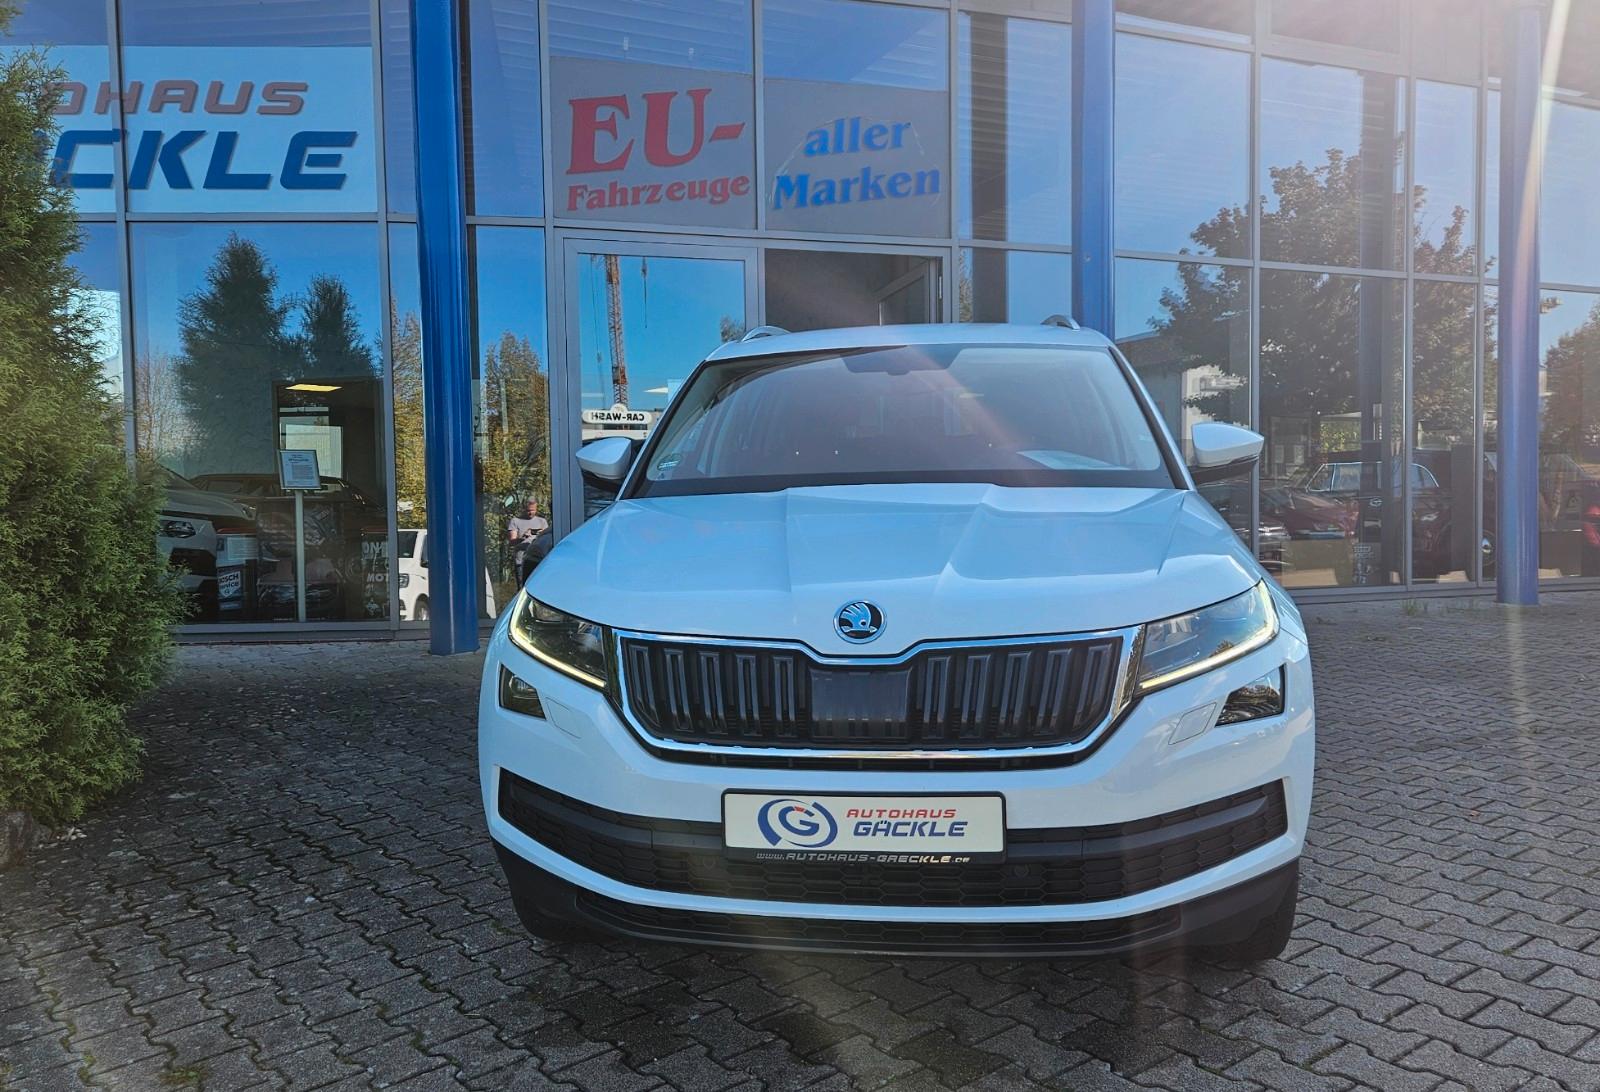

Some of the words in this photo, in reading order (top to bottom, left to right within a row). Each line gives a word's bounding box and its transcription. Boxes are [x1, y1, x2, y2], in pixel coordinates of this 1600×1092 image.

[566, 88, 746, 175] EU-
[803, 115, 912, 158] aller
[566, 175, 751, 211] Fahrzeuge
[772, 166, 941, 211] Marken
[846, 808, 957, 819] AUTOHAUS
[853, 820, 969, 838] GÄCKLE
